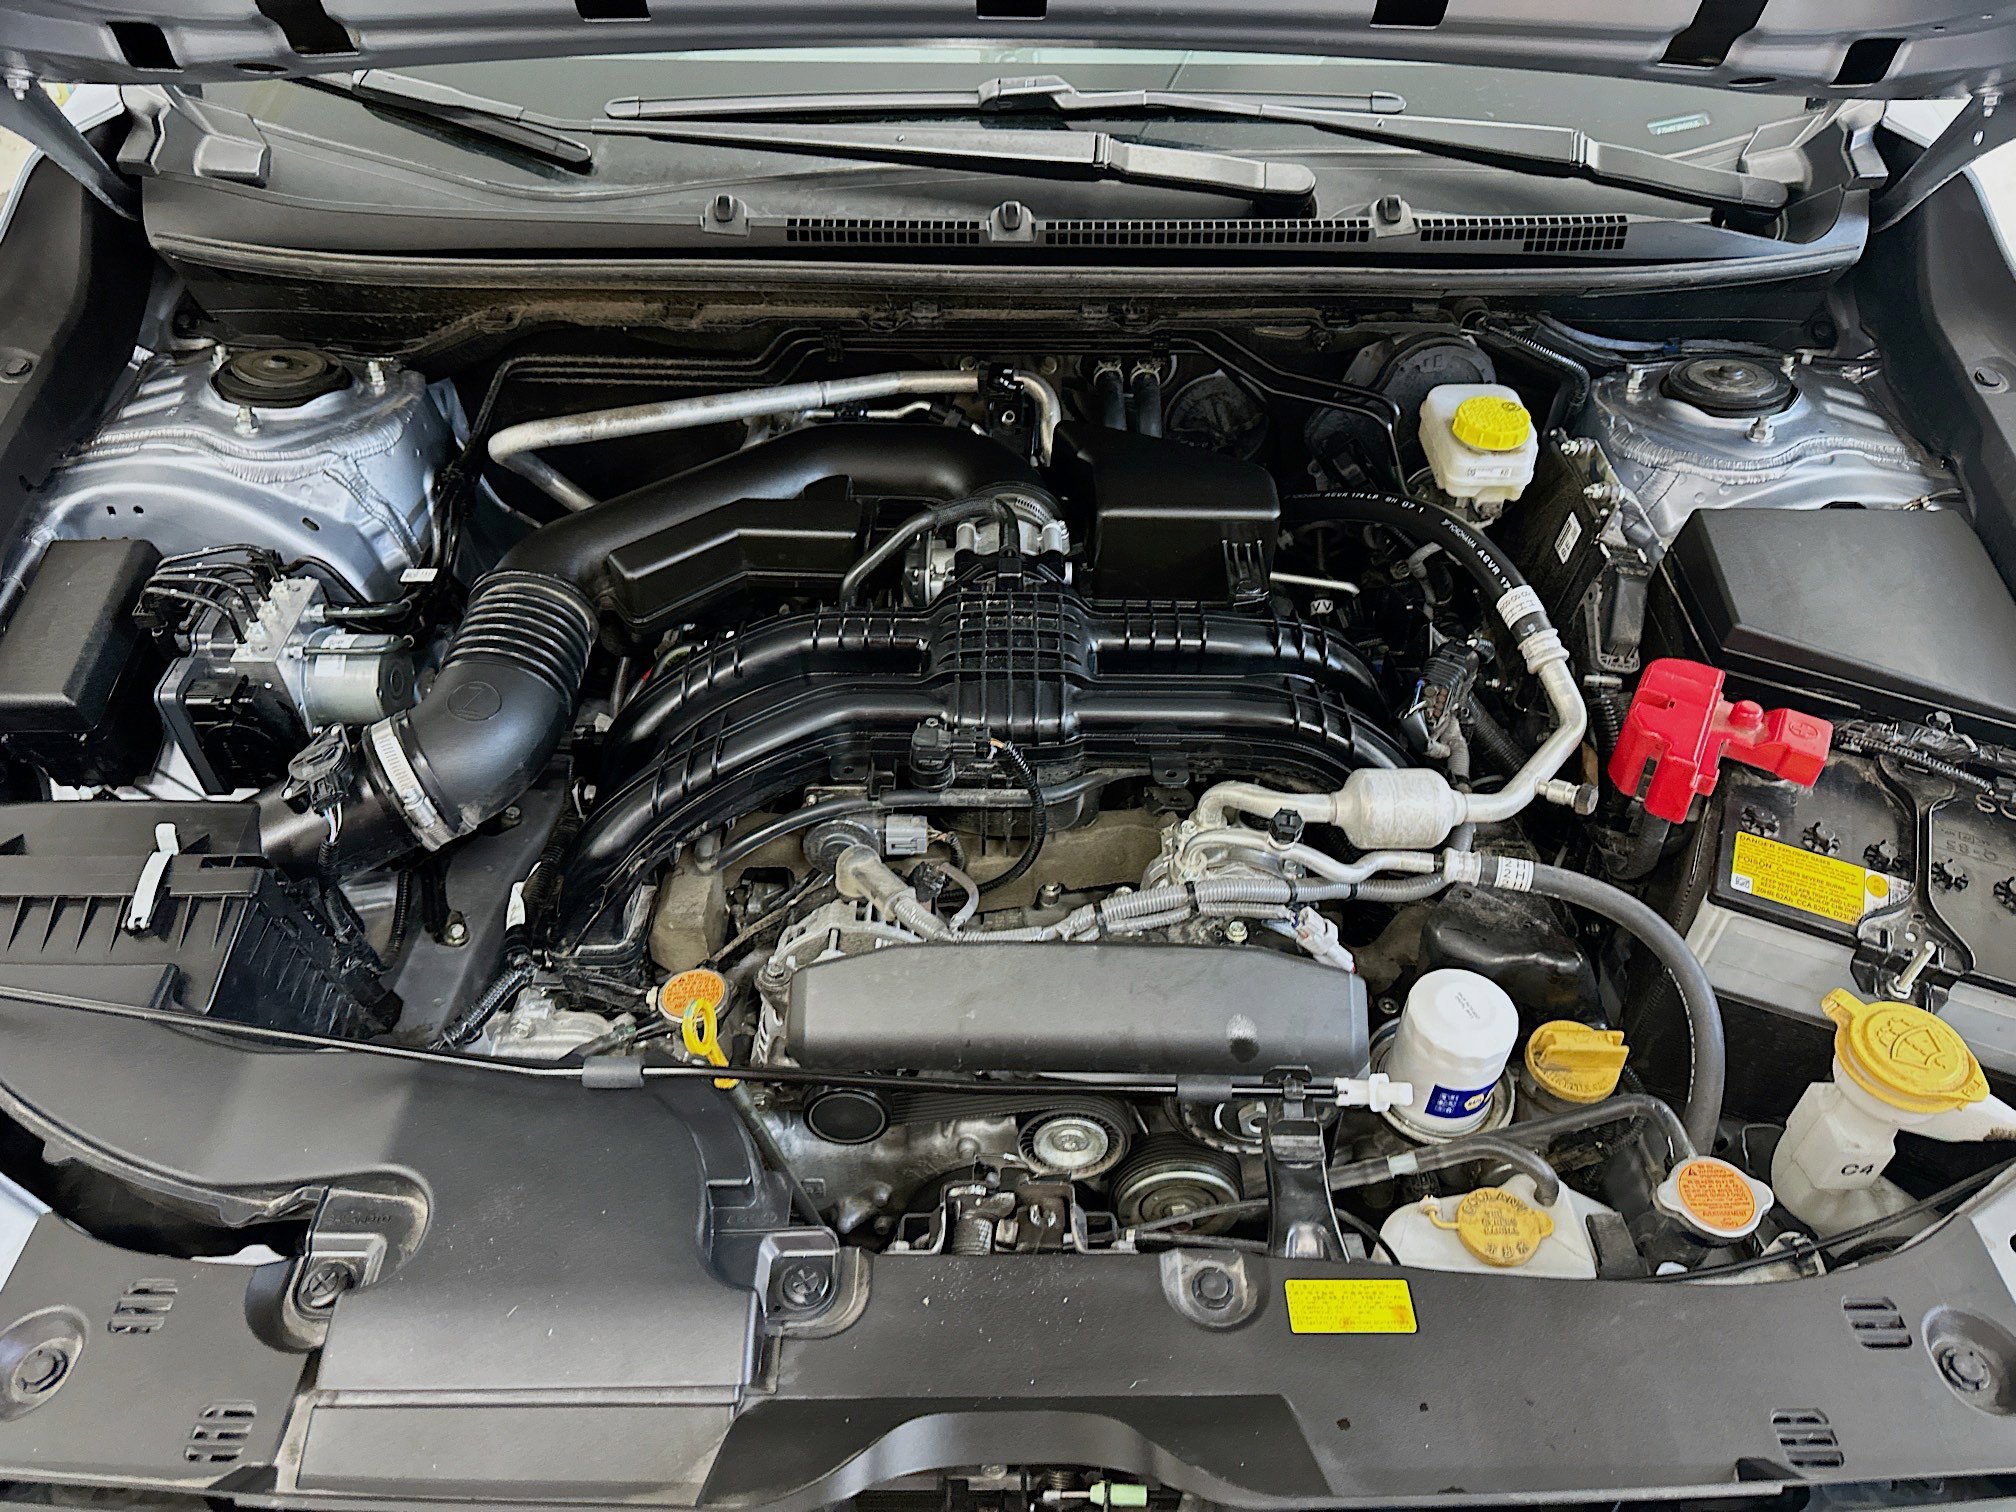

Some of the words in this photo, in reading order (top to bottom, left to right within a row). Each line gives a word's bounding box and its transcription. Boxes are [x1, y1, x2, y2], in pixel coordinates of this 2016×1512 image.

[1739, 834, 1775, 850] DANGER
[1777, 845, 1809, 859] EXPLOSIVE
[1810, 855, 1830, 866] GASES
[1737, 854, 1772, 870] POISON
[1776, 866, 1800, 877] CAUSES
[1801, 873, 1824, 885] SEVERE
[1825, 881, 1846, 892] BURNS
[1760, 875, 1776, 884] KEEP
[1777, 880, 1793, 890] VENT
[1794, 886, 1810, 895] CAPS
[1811, 891, 1828, 900] TIGHT
[1829, 896, 1842, 905] AND
[1843, 901, 1861, 911] LEVEL
[1760, 881, 1776, 890] KEEP
[1776, 886, 1788, 894] OUT
[1799, 893, 1820, 903] REACH
[1830, 902, 1861, 916] CHILDREN
[1796, 898, 1812, 908] CCA
[1840, 1162, 1875, 1177] C4
